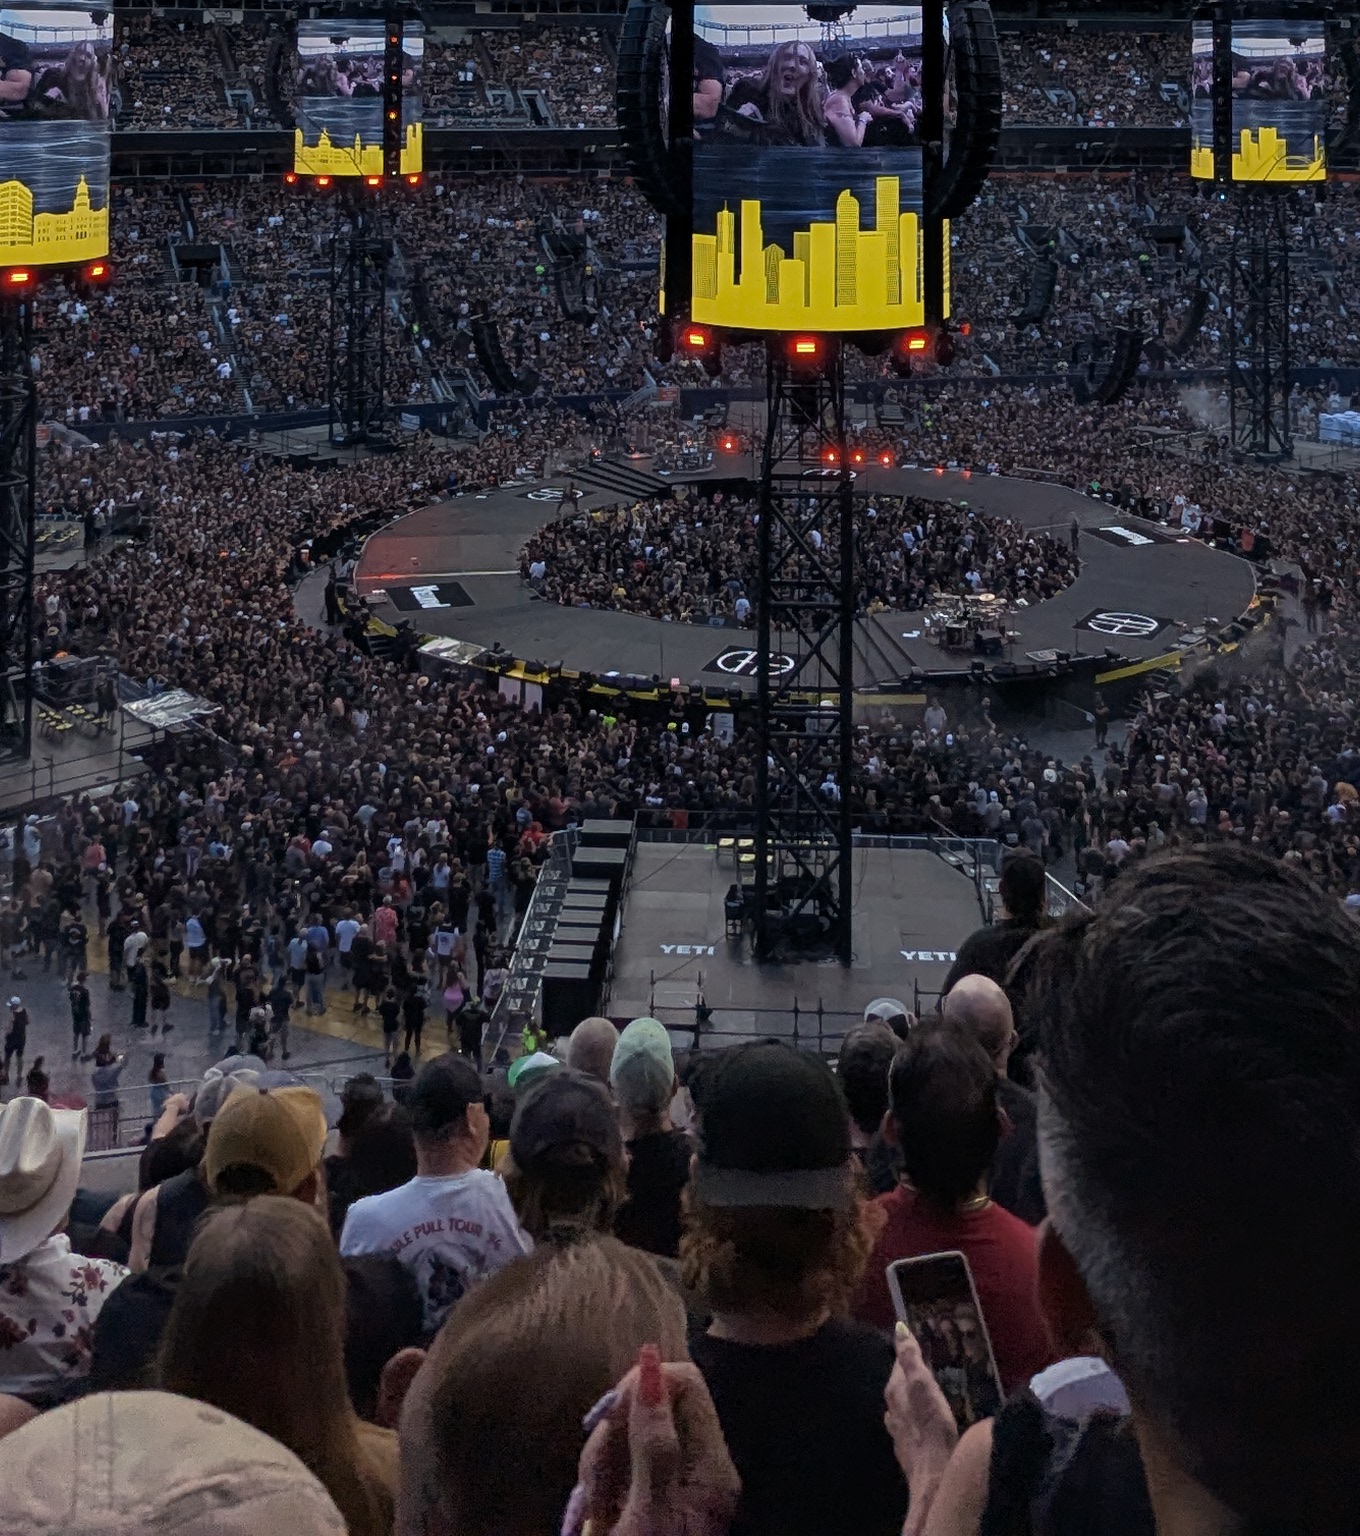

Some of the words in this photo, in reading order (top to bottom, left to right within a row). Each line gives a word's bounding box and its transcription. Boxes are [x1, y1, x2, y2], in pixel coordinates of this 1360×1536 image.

[660, 944, 716, 956] YETI
[900, 949, 957, 961] YETI
[413, 1219, 445, 1240] PULL
[448, 1217, 484, 1238] TOUR
